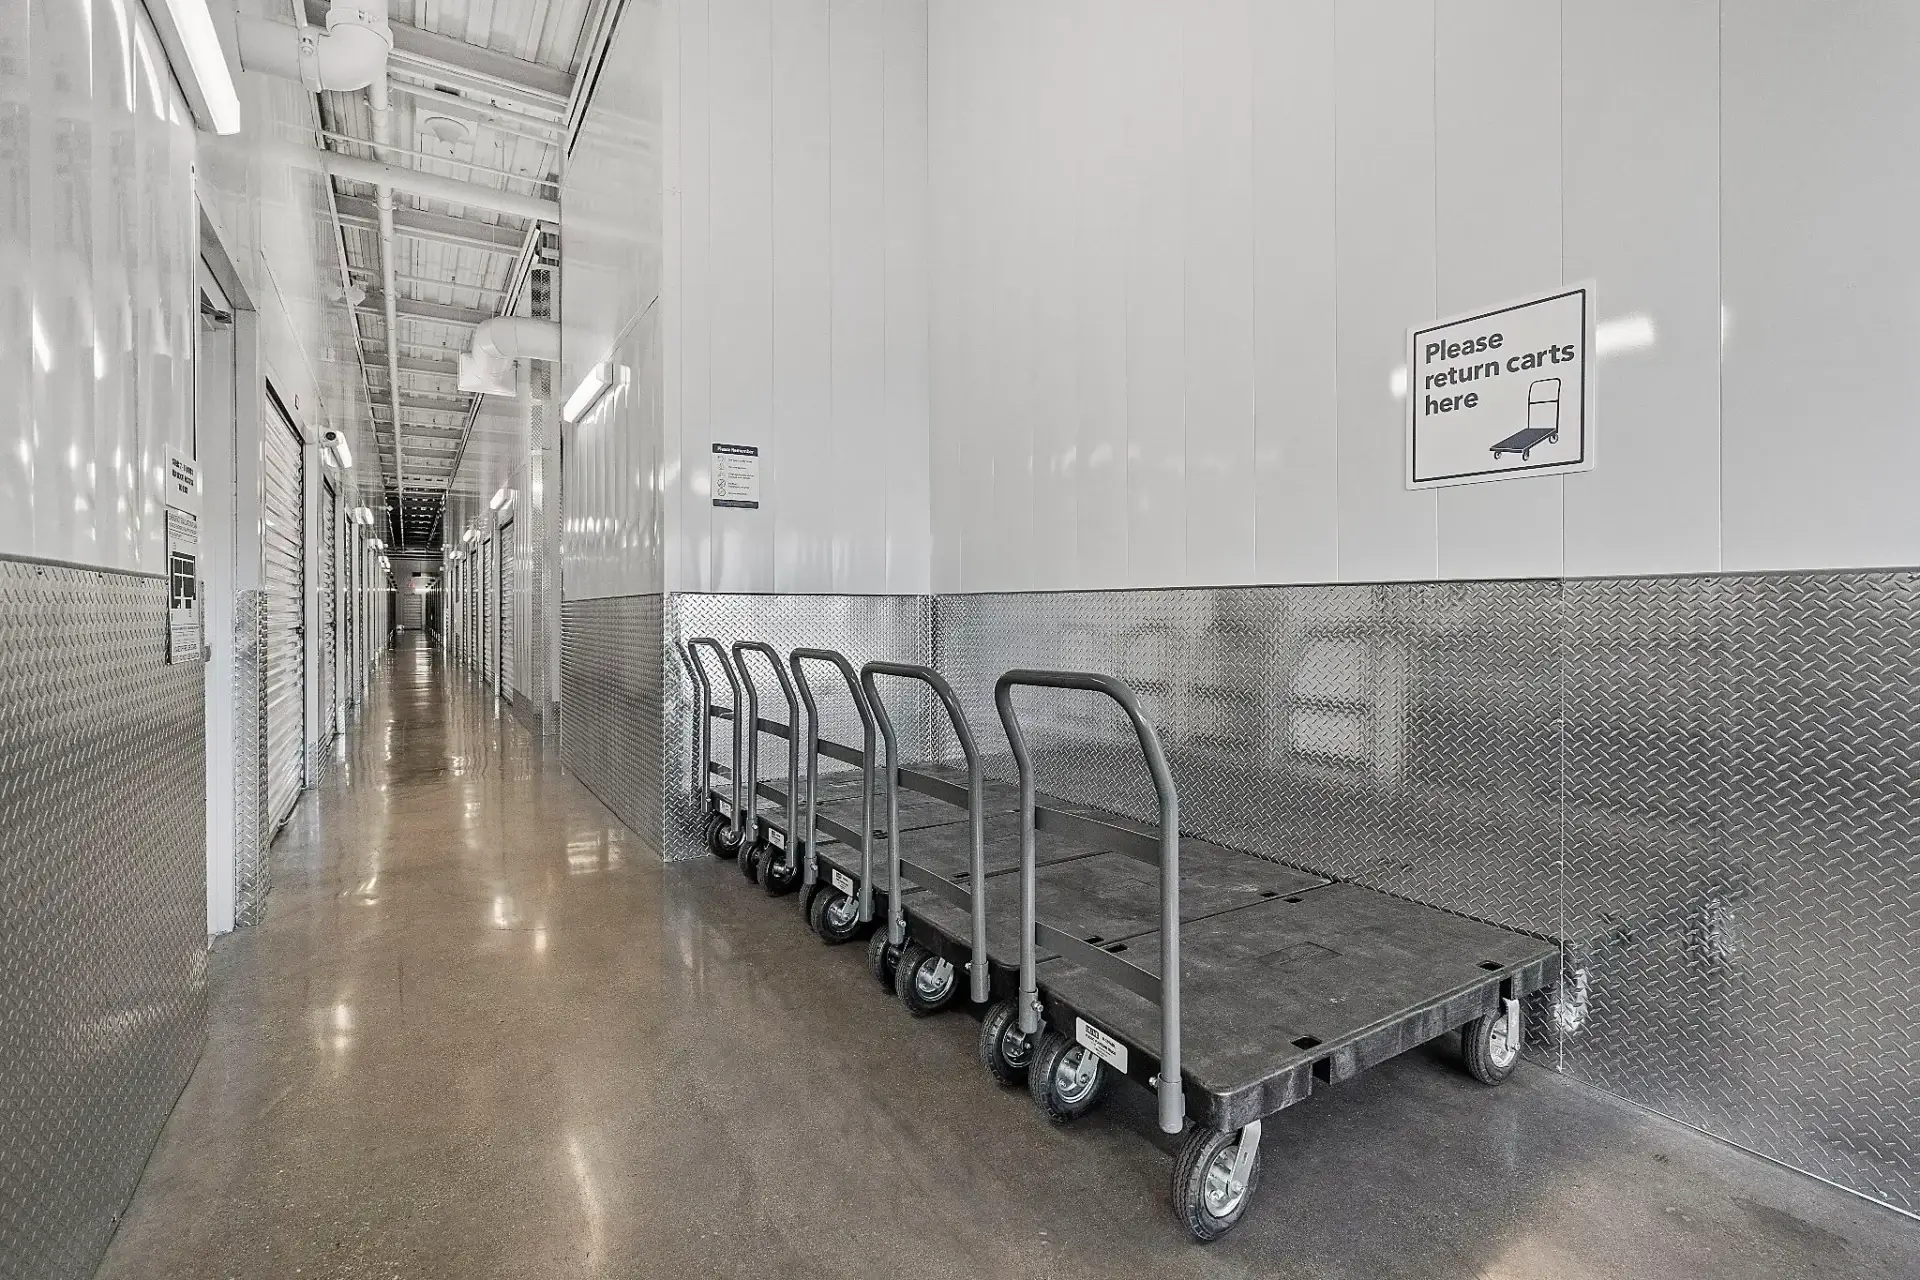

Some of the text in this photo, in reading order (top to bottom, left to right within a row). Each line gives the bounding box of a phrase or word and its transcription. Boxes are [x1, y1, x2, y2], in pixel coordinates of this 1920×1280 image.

[1425, 332, 1504, 364] Please
[1425, 344, 1575, 390] return carts
[1425, 392, 1479, 416] here
